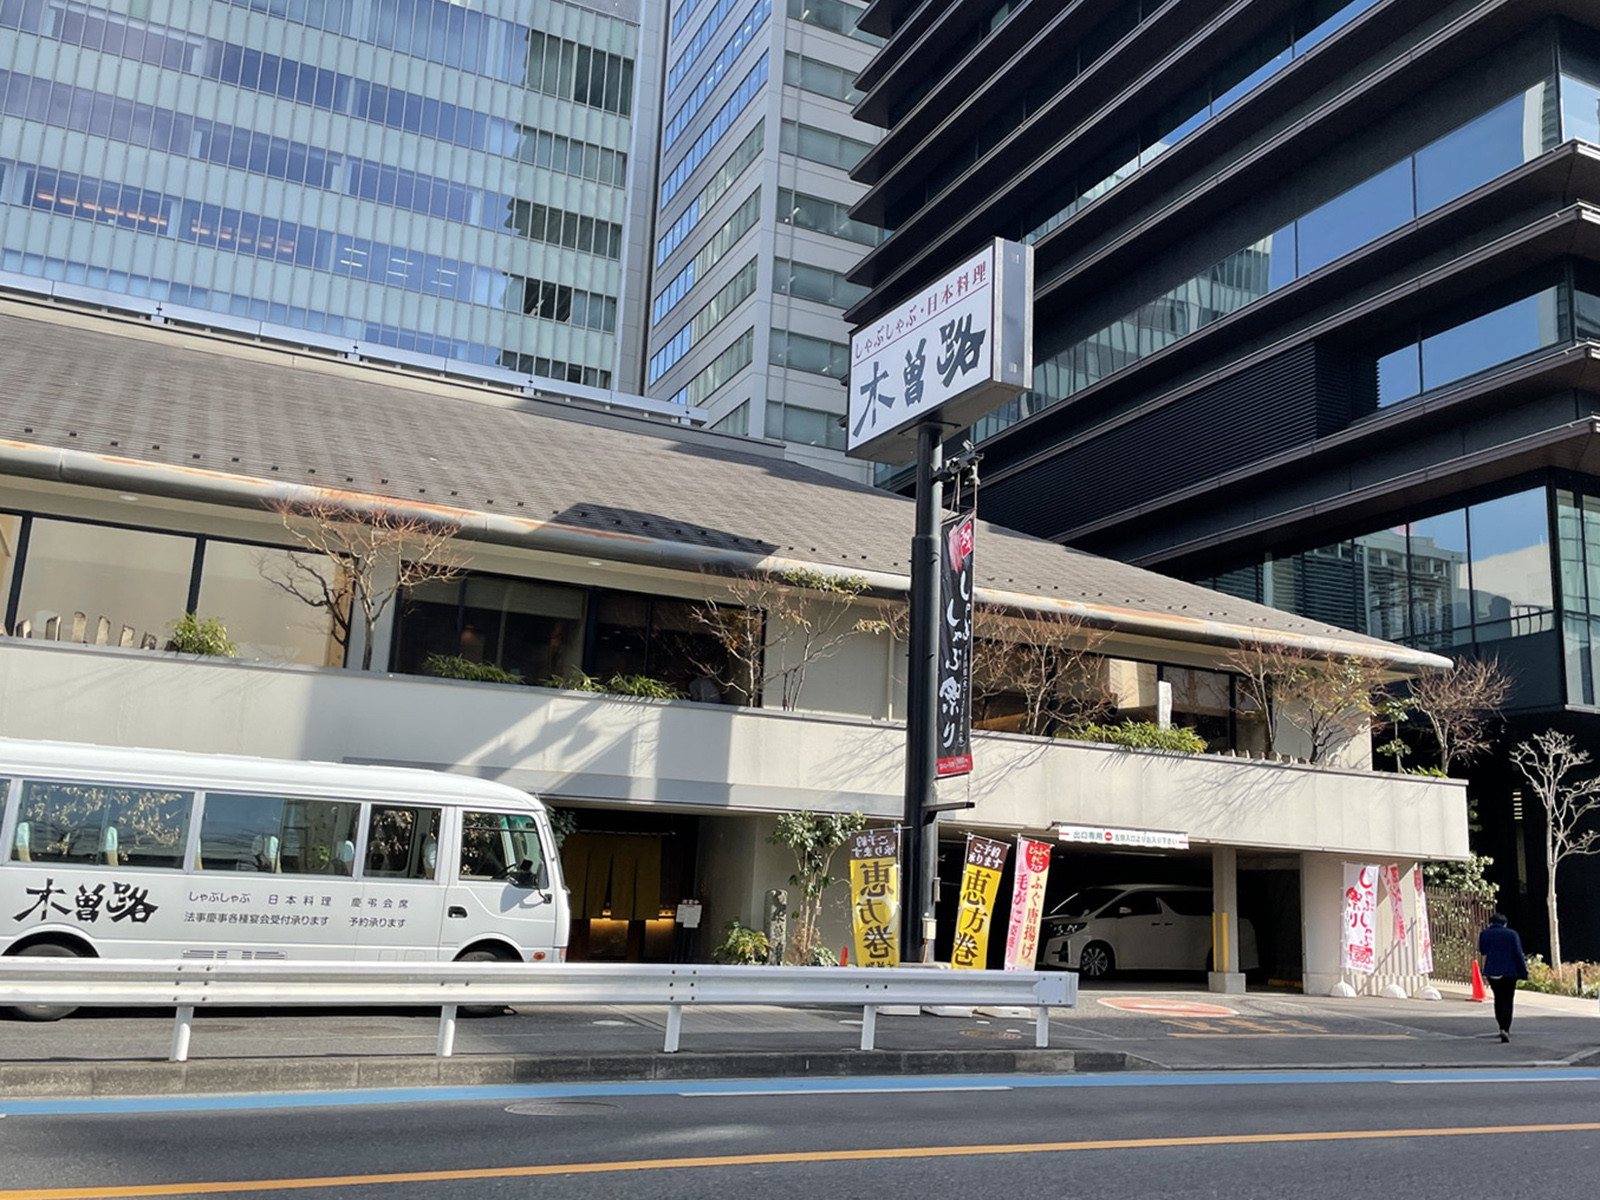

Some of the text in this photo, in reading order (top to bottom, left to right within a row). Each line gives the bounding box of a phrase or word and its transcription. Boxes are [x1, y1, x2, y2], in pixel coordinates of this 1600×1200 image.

[854, 260, 987, 360] しゃぶしゃぶ・日本料理
[853, 313, 987, 438] 木曽路
[967, 853, 1003, 869] 承ります
[973, 843, 1002, 858] ご予約
[13, 877, 159, 923] 木曽路
[184, 911, 406, 928] 法事慶事各種宴会受付承ります 予約承ります
[188, 891, 409, 909] しゃぶしゃぶ 日本料理 慶弔会席
[953, 870, 992, 967] 恵方巻
[1022, 876, 1043, 960] ふぐ唐揚げ
